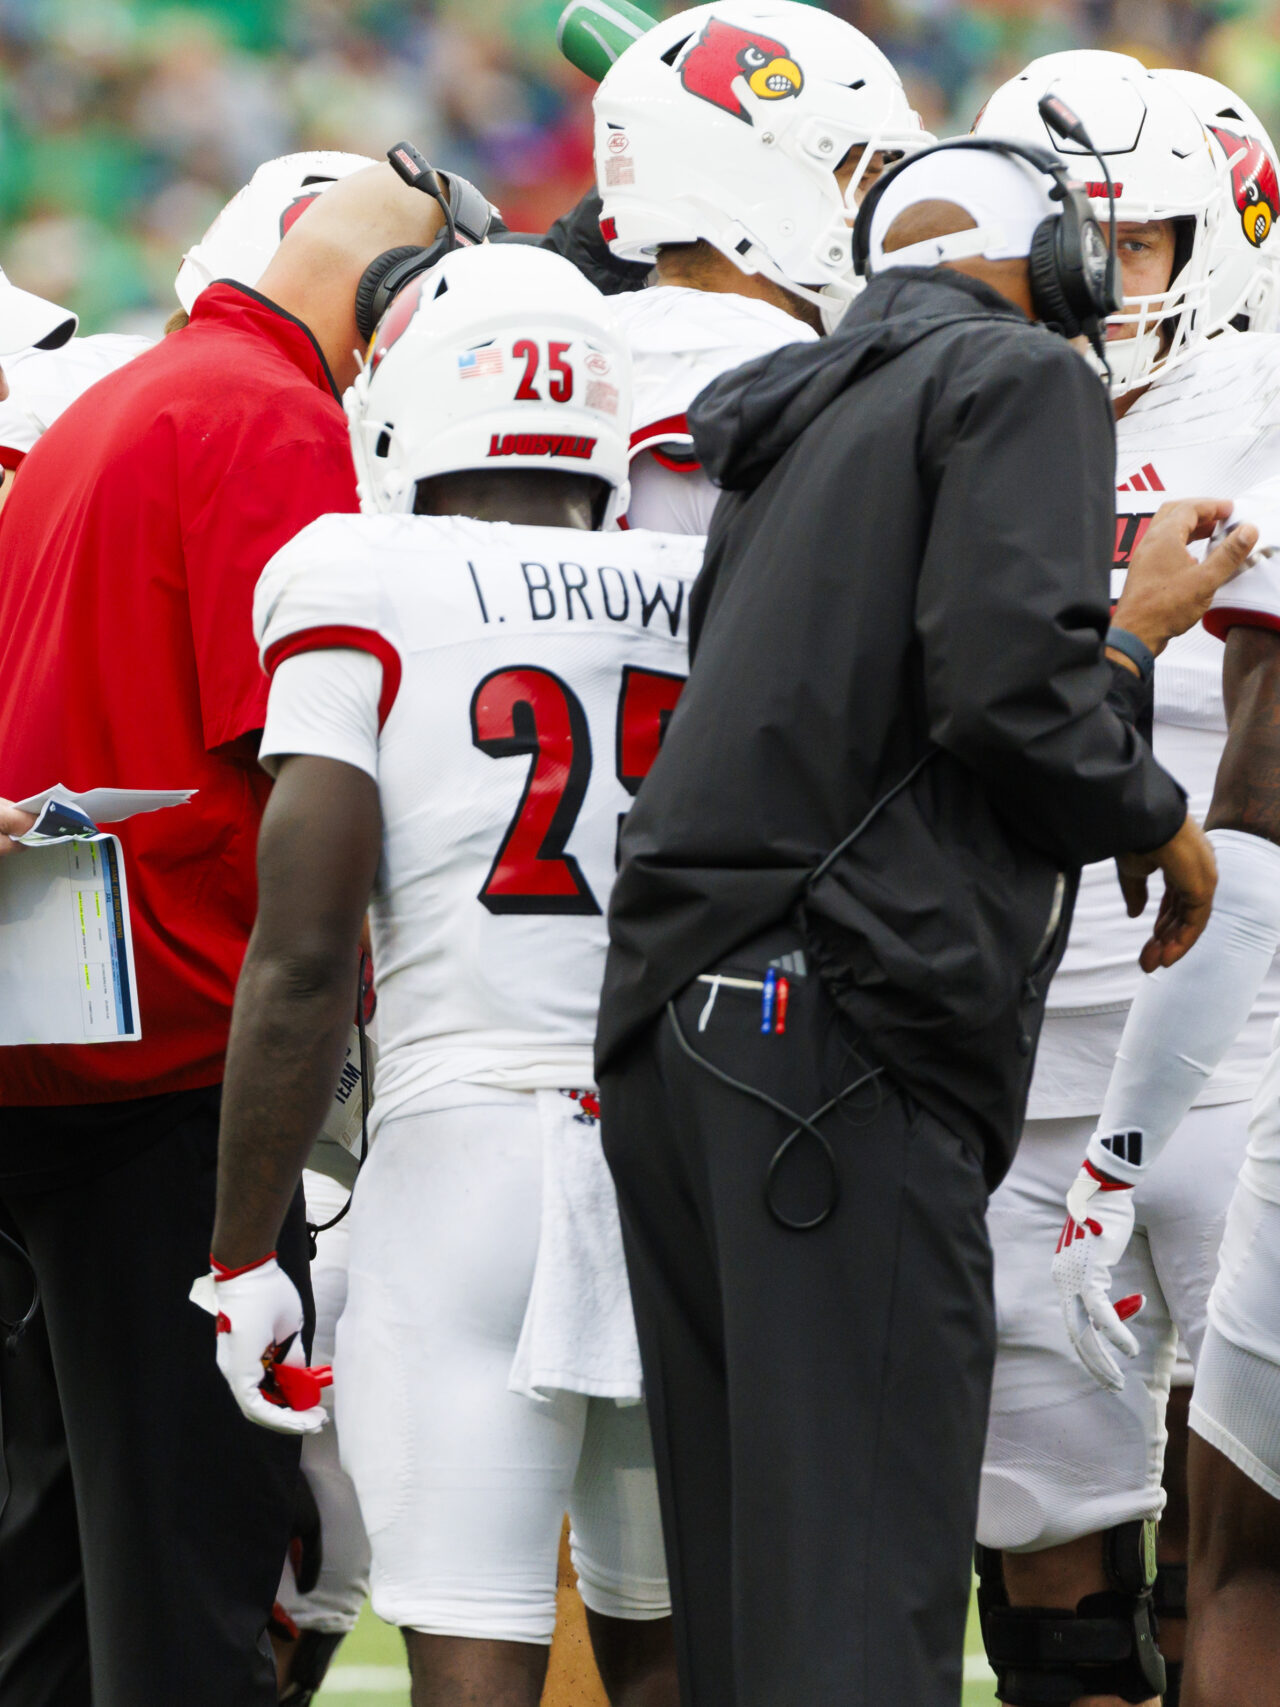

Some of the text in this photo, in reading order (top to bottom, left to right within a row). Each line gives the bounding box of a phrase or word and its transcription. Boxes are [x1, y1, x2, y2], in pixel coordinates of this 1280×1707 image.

[512, 339, 573, 404] 25
[486, 433, 598, 459] LOUISVILLE
[467, 560, 685, 637] I. BROW
